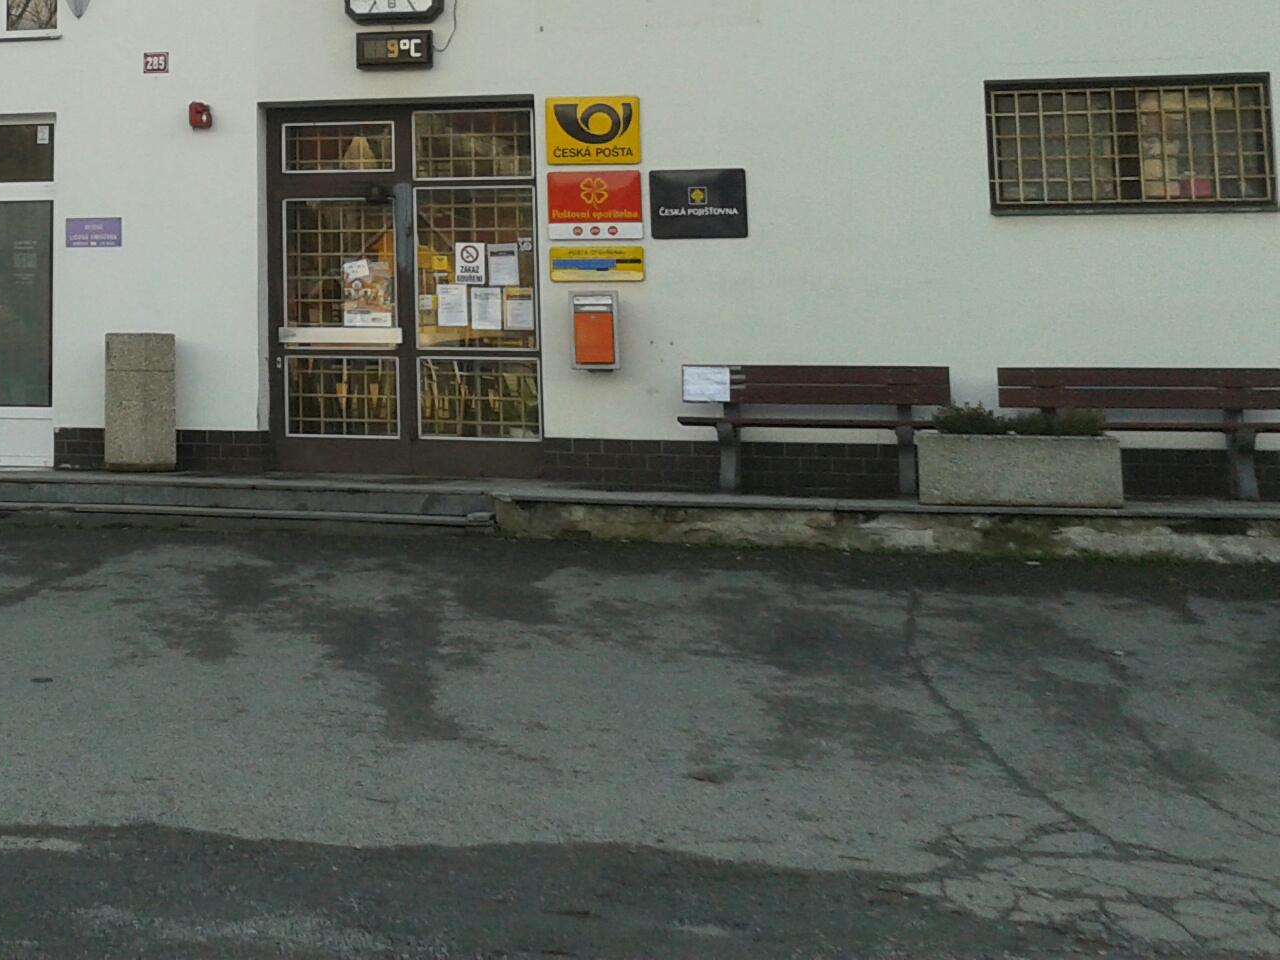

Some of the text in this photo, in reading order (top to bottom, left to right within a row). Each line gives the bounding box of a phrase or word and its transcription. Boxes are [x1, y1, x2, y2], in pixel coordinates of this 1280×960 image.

[146, 56, 166, 70] 285
[553, 145, 634, 158] ČESKÁ POŠTA
[658, 206, 686, 216] ČESKÁ
